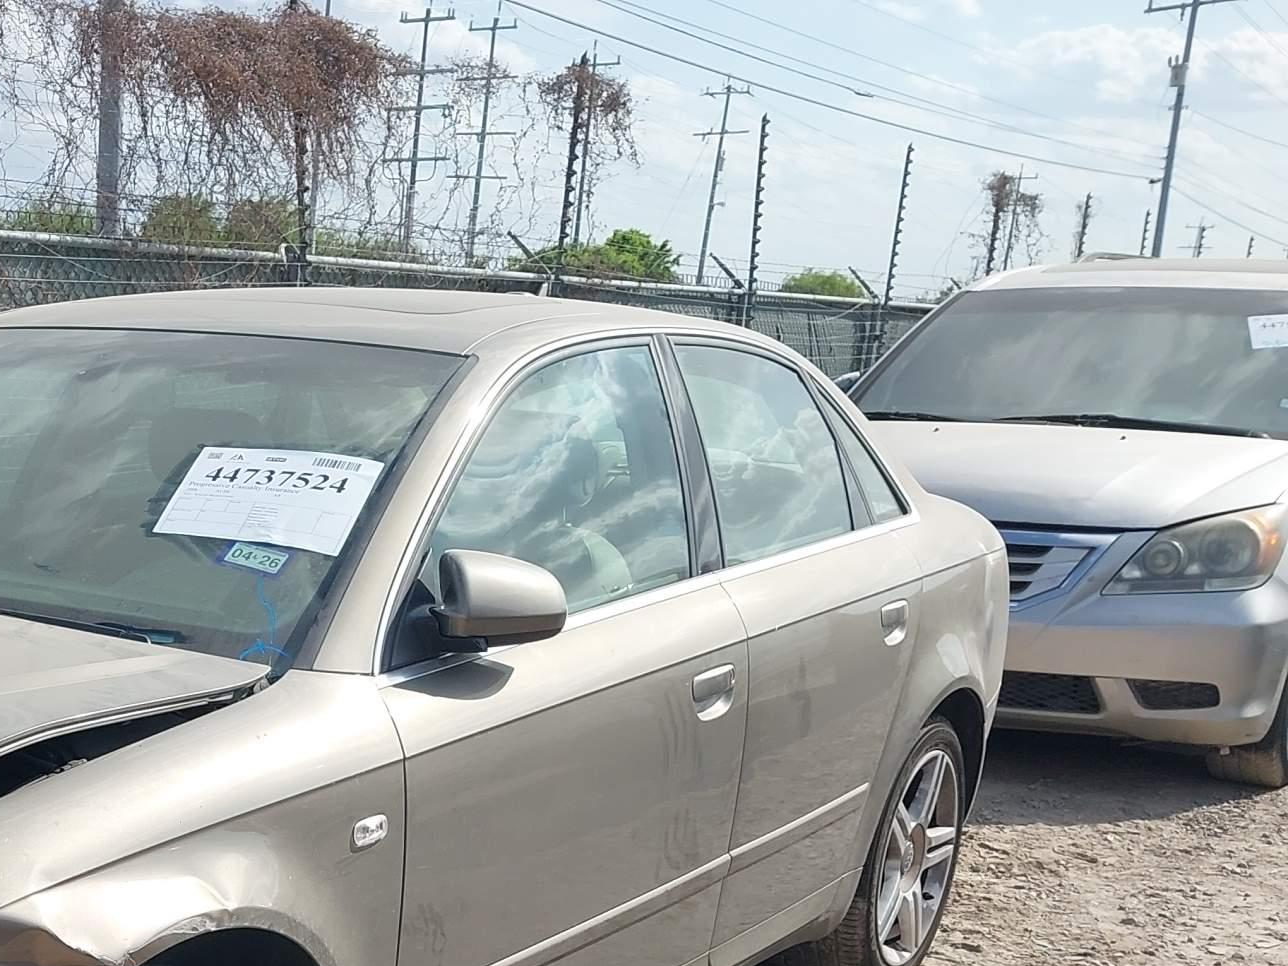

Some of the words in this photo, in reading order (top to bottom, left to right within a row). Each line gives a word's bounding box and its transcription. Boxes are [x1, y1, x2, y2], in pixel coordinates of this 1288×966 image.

[204, 466, 349, 494] 44737524
[231, 548, 253, 561] 04
[258, 555, 281, 568] 26
